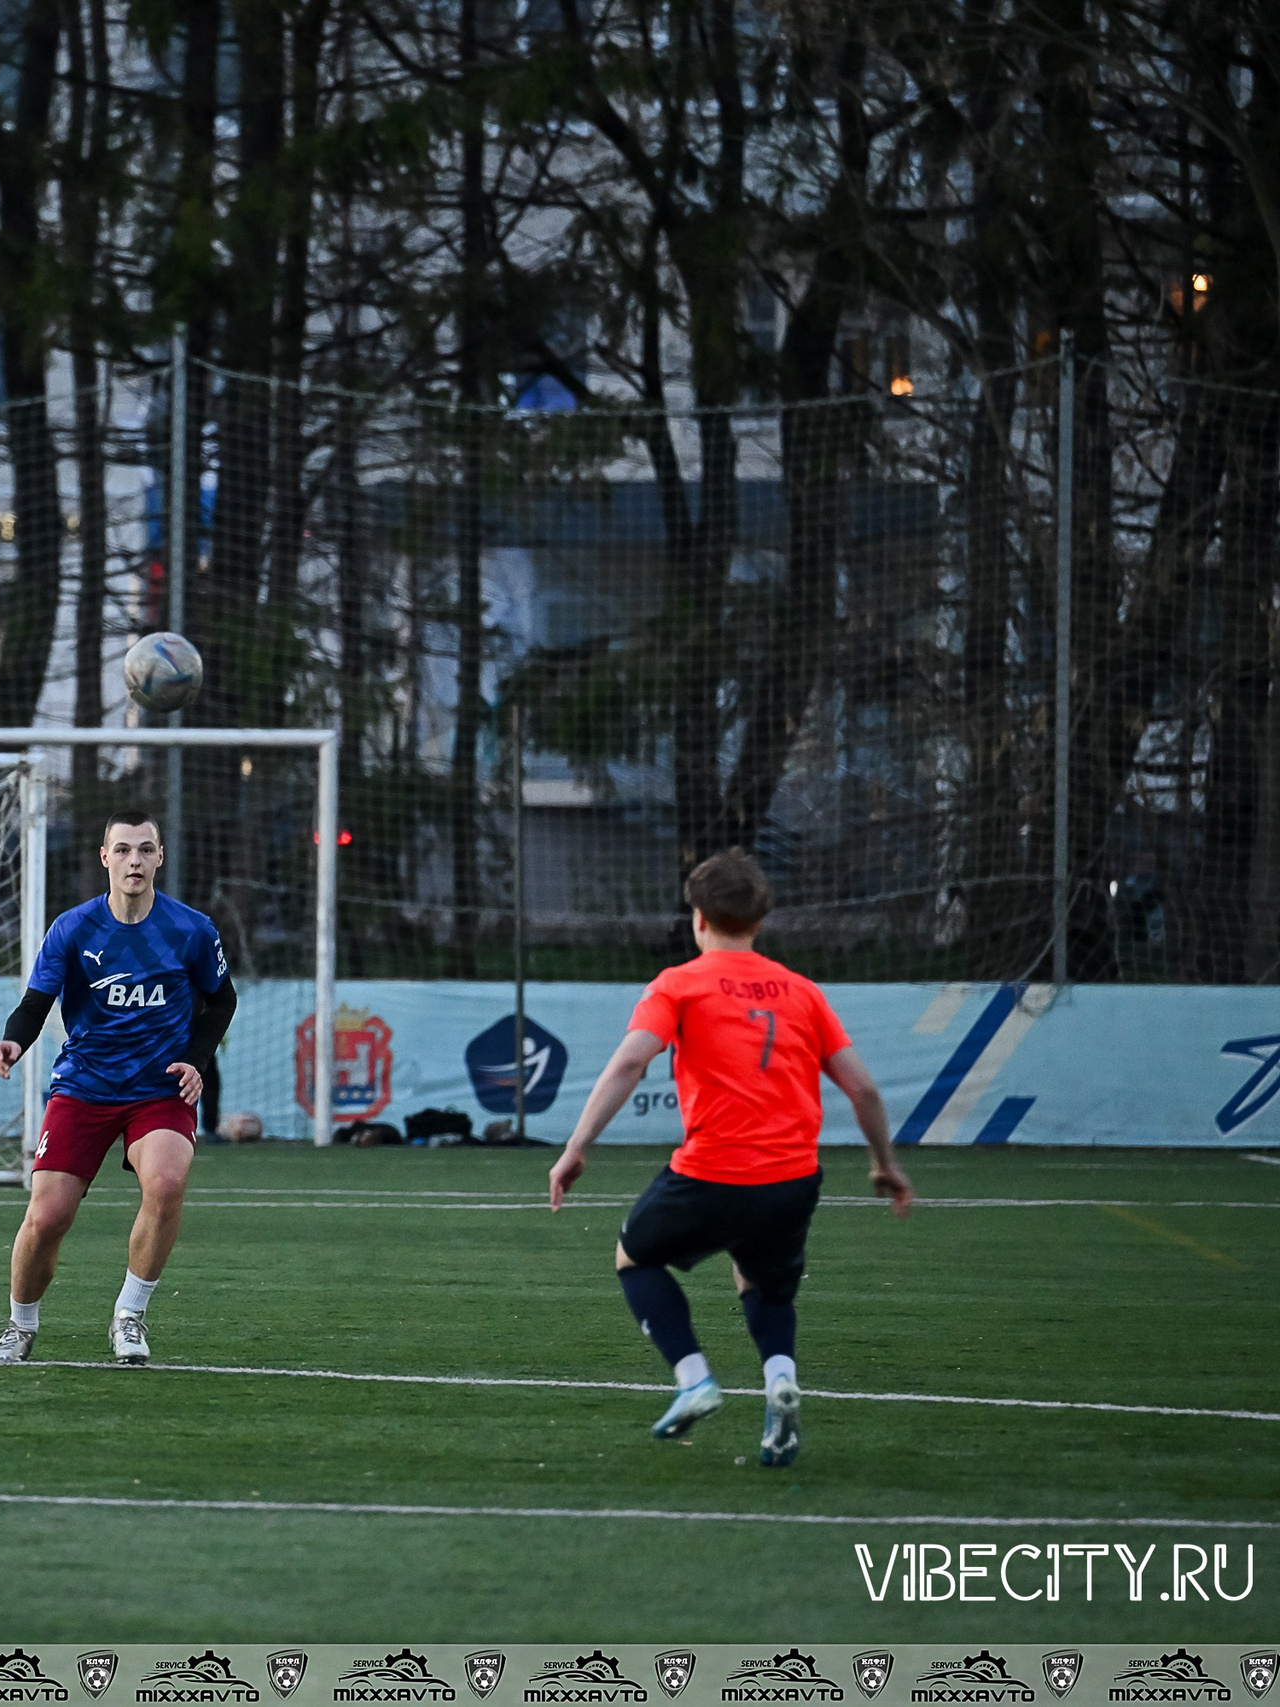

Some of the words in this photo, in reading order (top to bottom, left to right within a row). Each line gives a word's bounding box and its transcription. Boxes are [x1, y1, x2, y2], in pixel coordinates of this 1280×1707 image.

[107, 984, 167, 1007] ВАД
[748, 1009, 775, 1070] 7
[35, 1130, 50, 1159] 4
